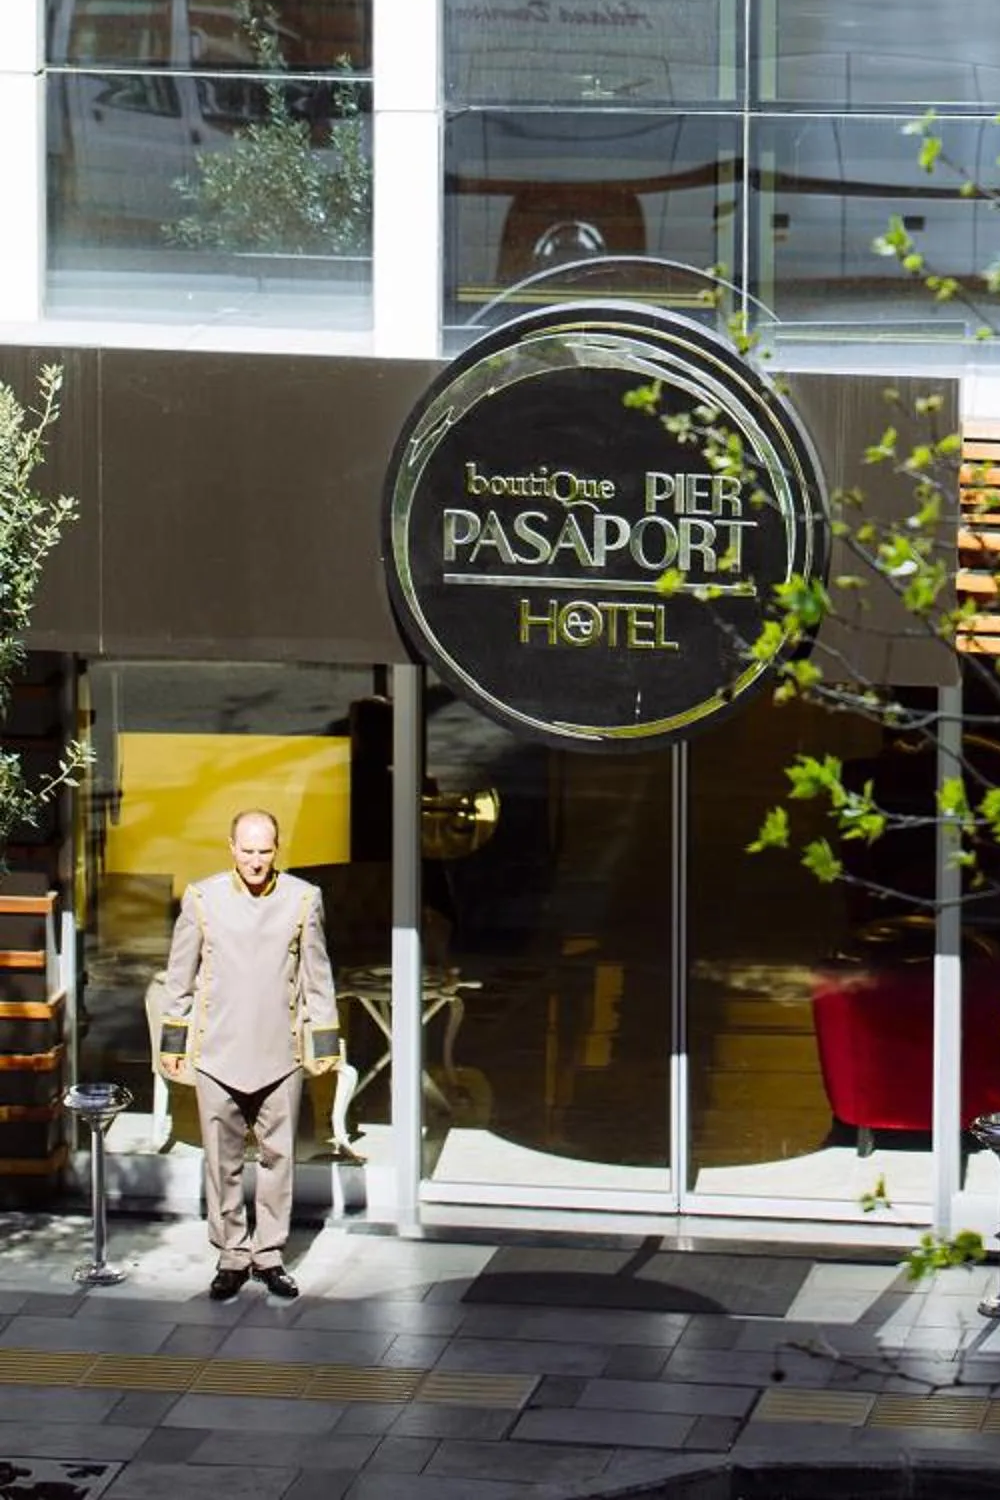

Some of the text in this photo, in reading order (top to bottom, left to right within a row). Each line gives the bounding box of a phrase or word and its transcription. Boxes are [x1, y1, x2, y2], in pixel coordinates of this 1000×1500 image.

[645, 472, 743, 516] PIER
[443, 509, 758, 573] PASAPORT
[519, 599, 679, 650] HOTEL
